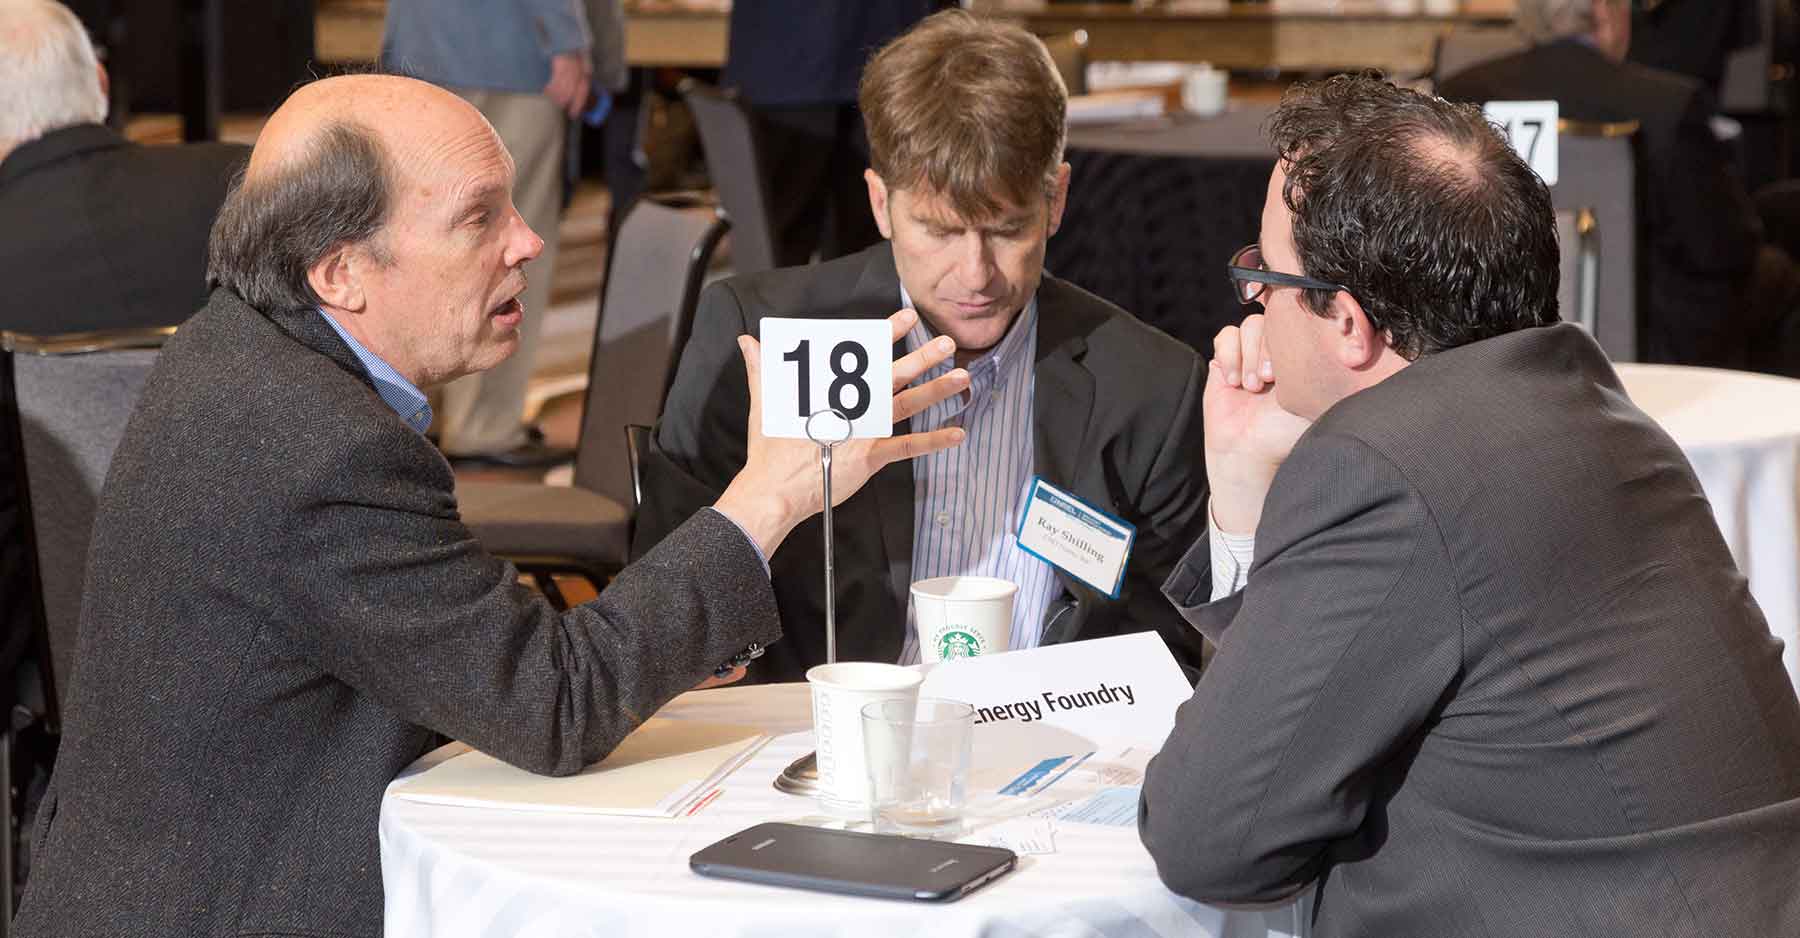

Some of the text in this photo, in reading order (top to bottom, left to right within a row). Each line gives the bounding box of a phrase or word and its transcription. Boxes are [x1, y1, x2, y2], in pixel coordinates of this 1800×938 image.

[783, 339, 871, 421] 18
[1037, 516, 1060, 535] Ray
[1061, 526, 1105, 564] Shilling
[1042, 683, 1136, 713] Foundry
